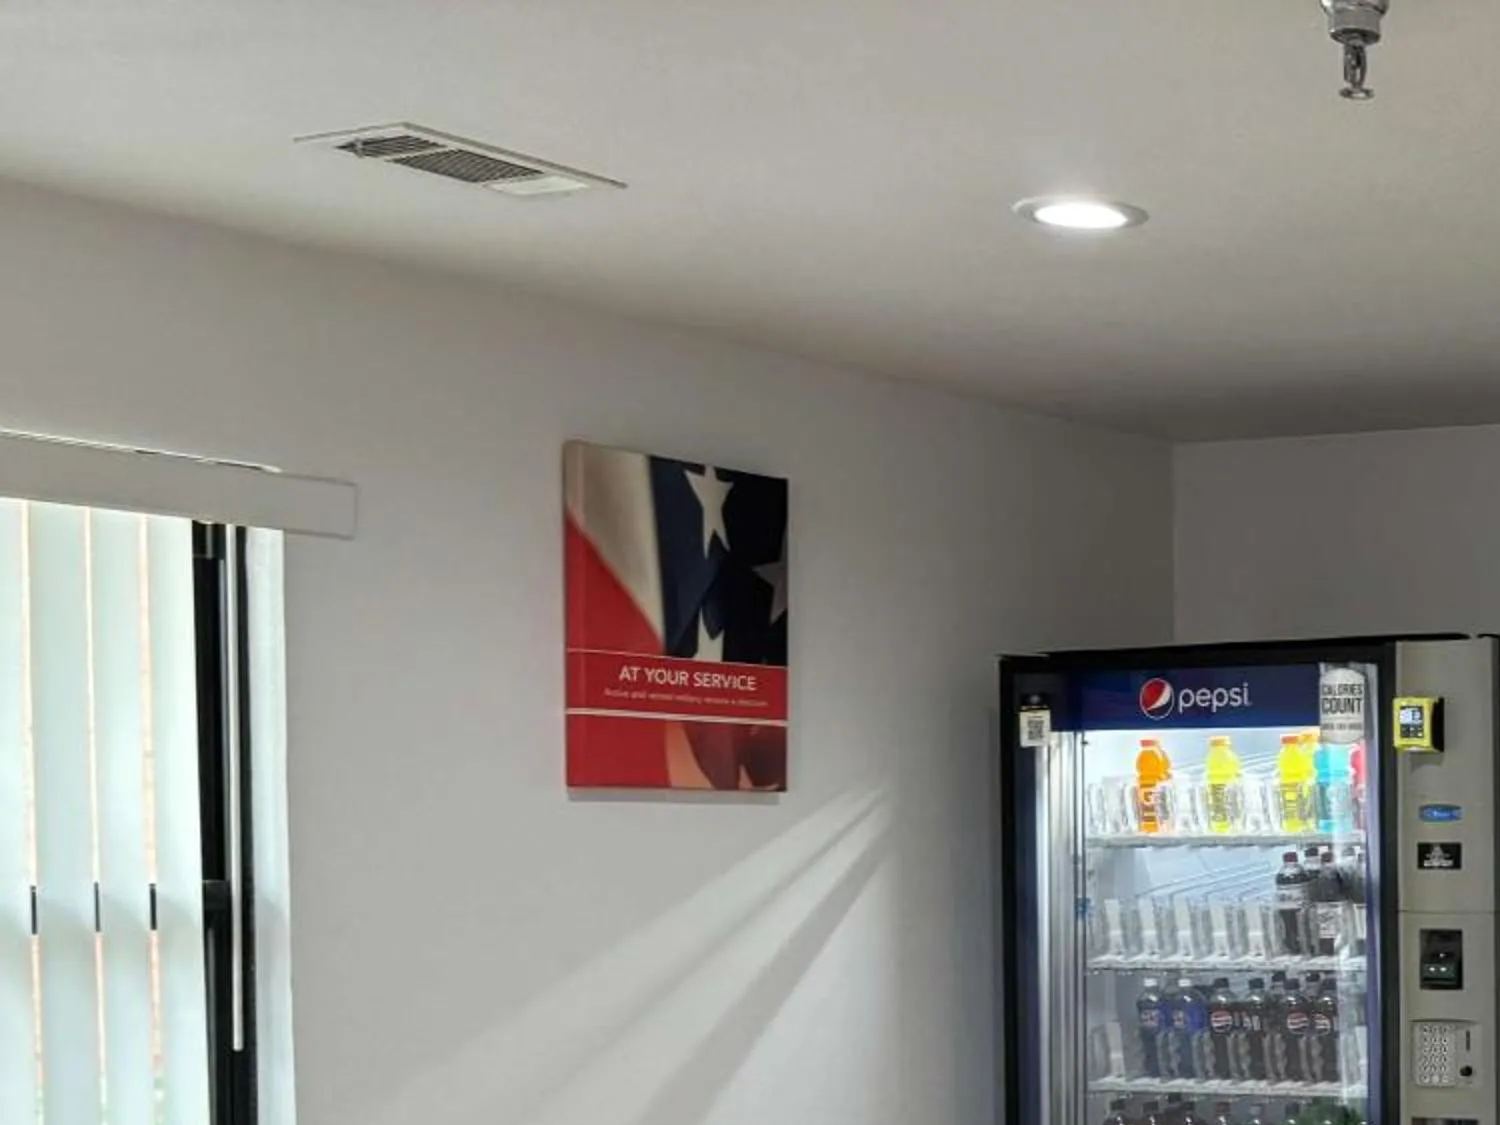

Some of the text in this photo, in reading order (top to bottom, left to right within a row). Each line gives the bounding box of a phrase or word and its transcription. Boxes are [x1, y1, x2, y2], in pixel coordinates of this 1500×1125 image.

[618, 664, 757, 692] AT YOUR SERVICE
[1178, 682, 1249, 714] pepsi
[1321, 697, 1362, 714] COUNT
